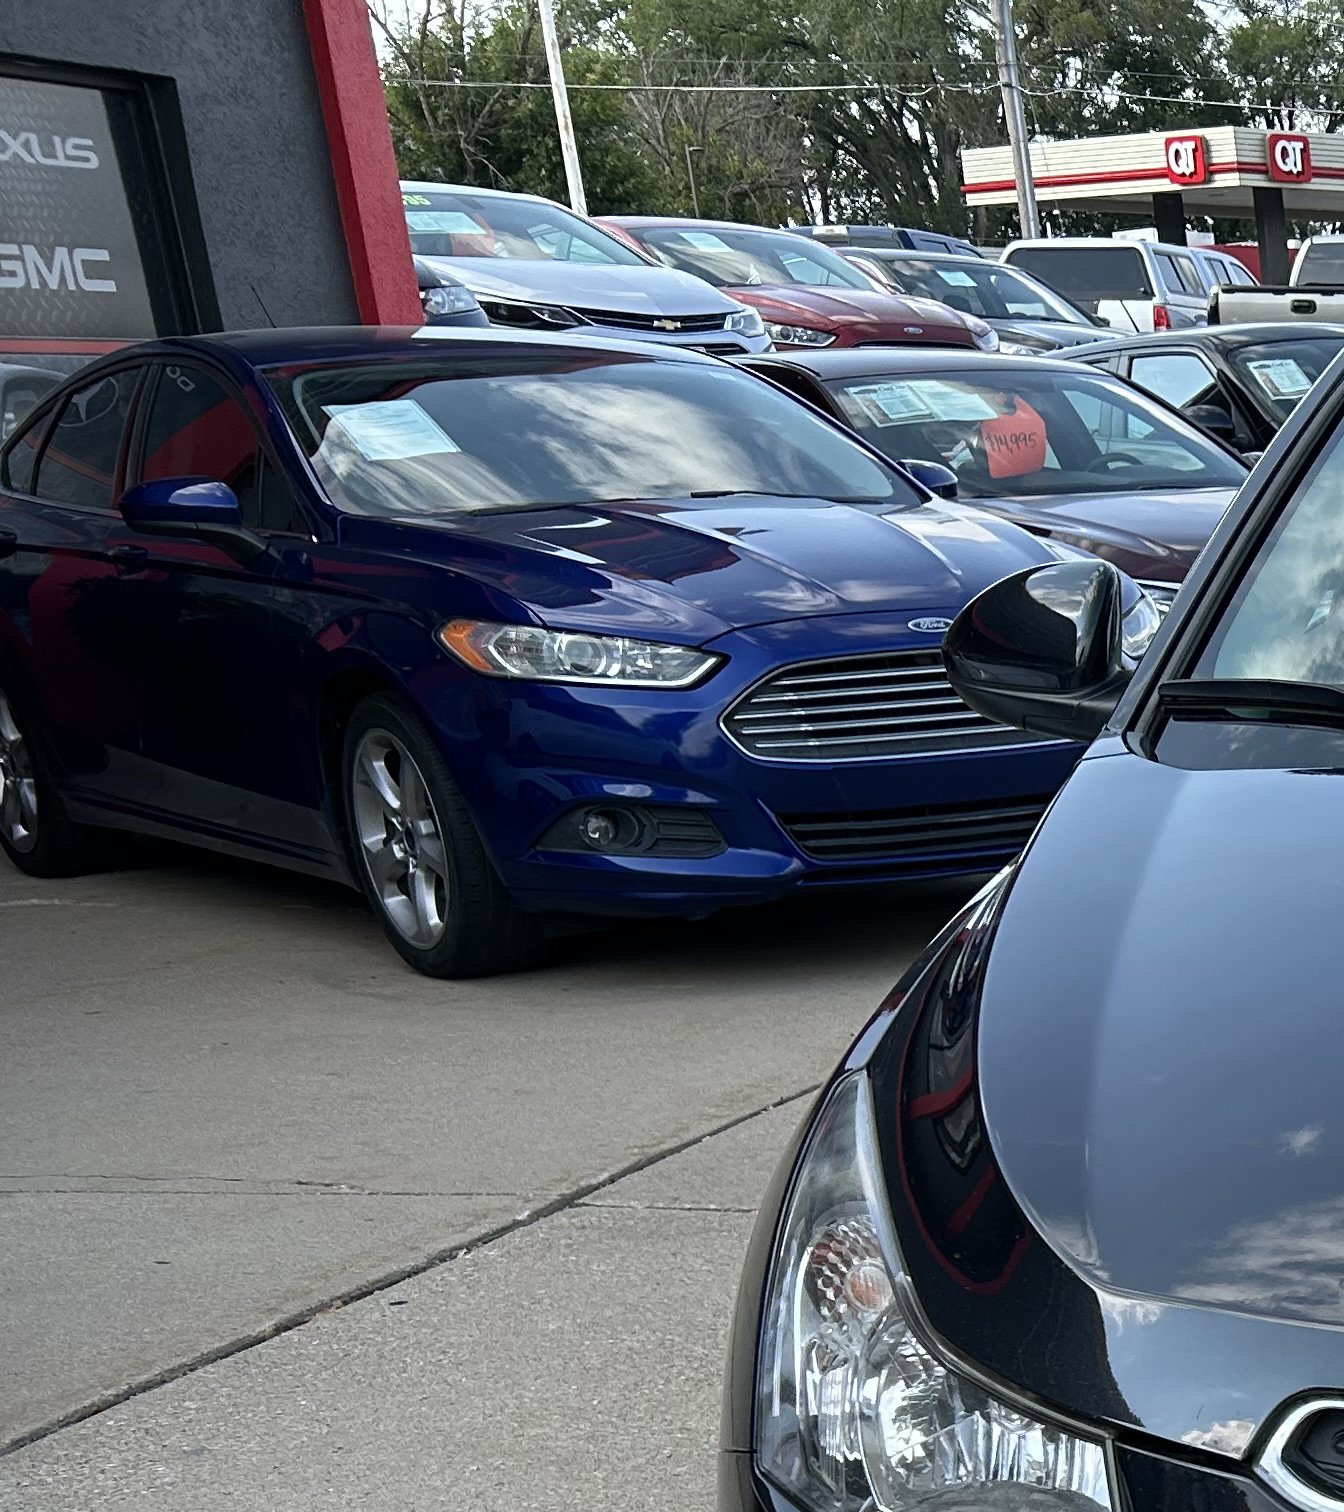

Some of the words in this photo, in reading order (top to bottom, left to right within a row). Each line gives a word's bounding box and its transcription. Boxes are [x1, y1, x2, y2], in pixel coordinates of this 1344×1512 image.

[1168, 140, 1196, 177] QT
[1275, 139, 1304, 175] QT
[986, 431, 1037, 455] $14,995
